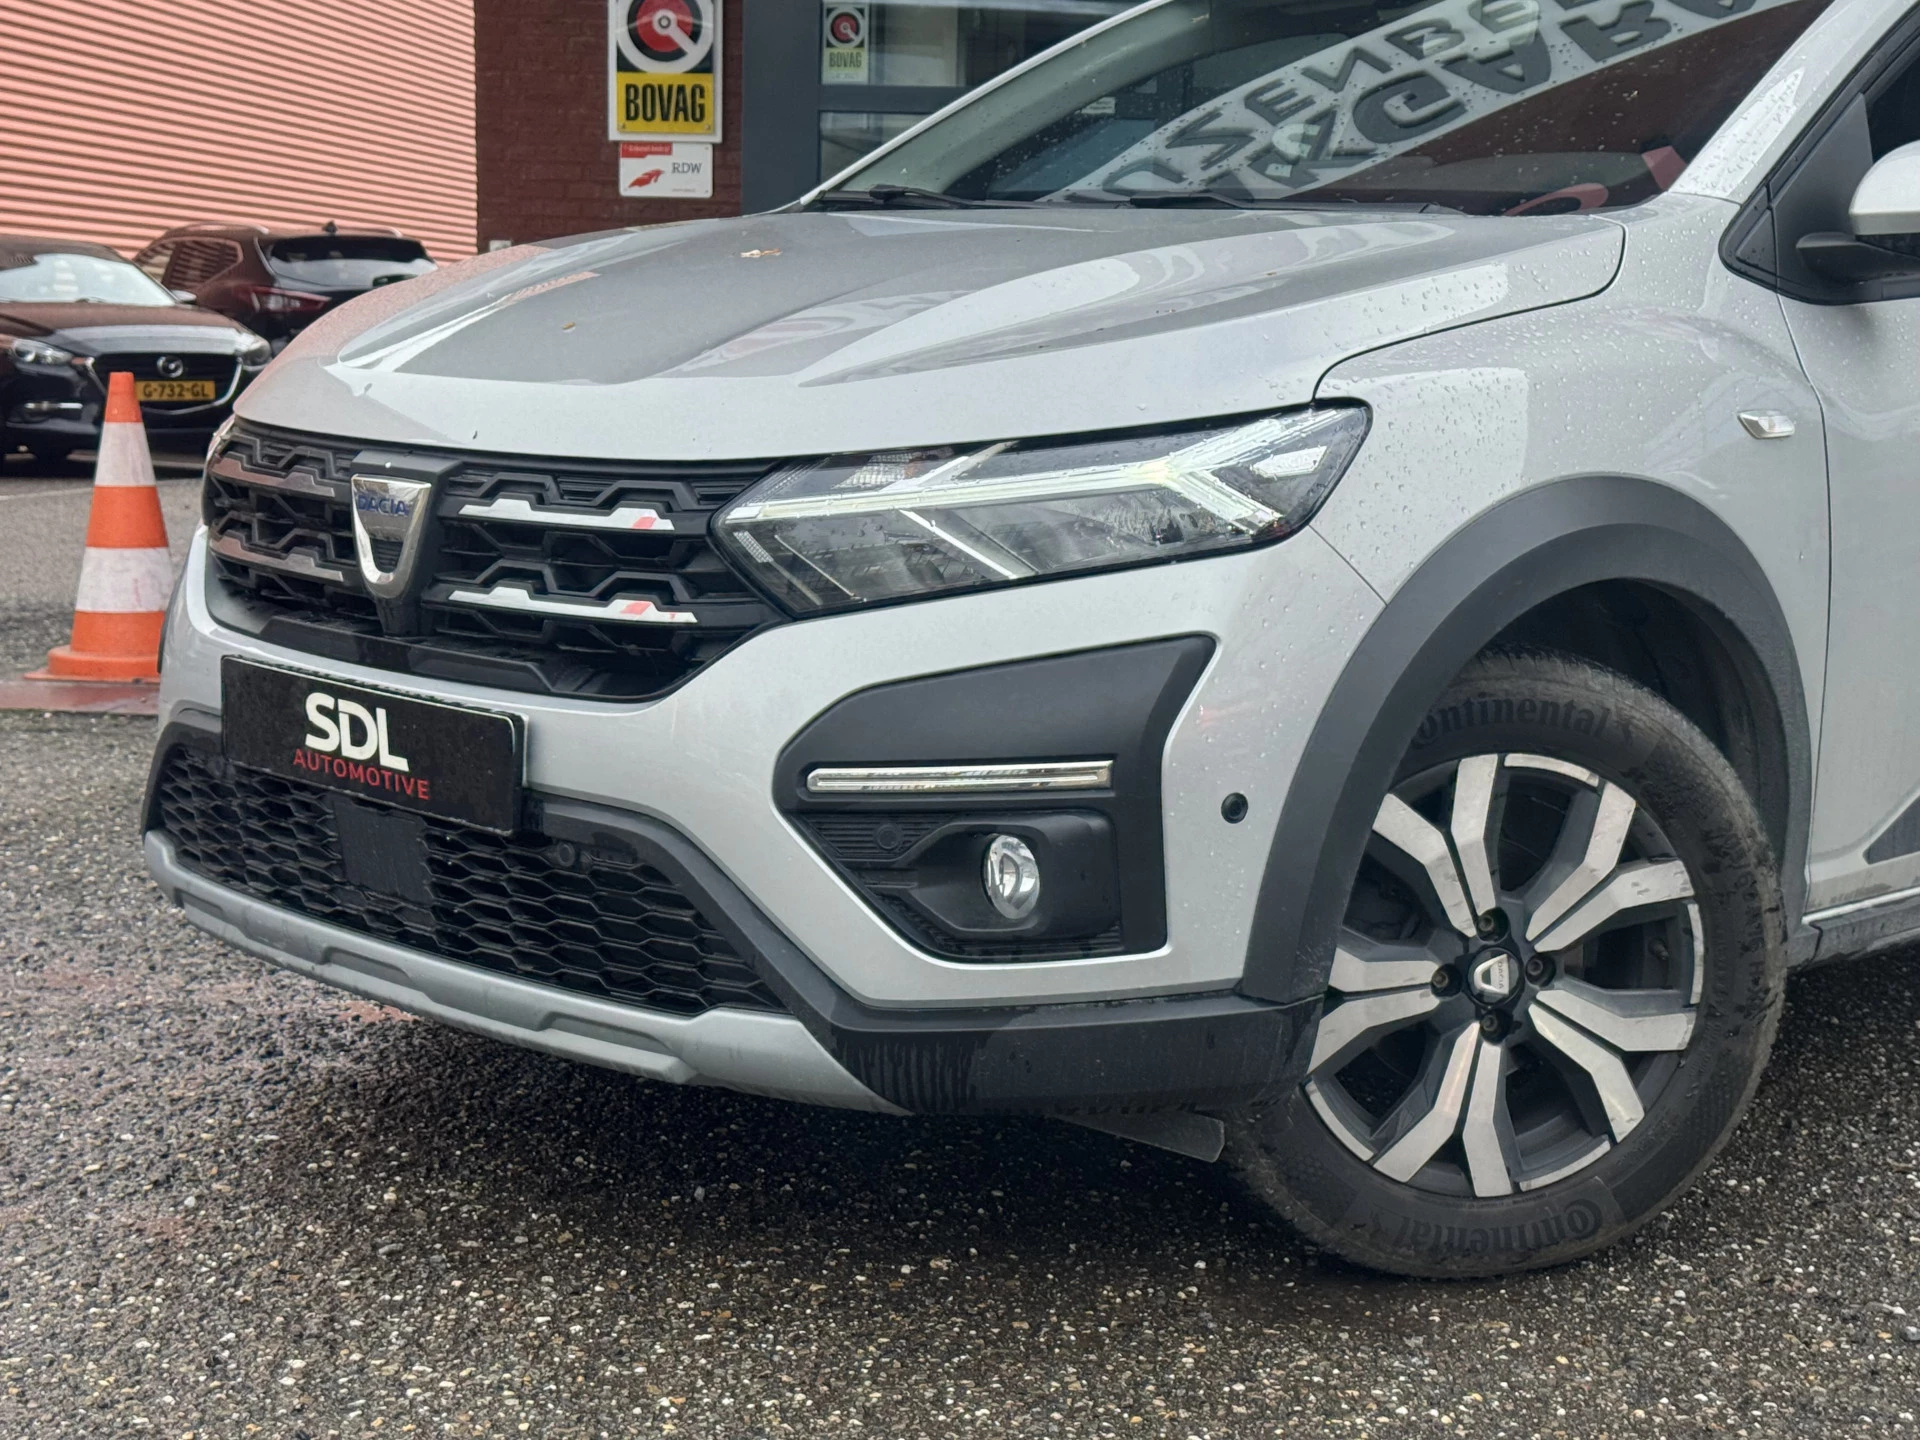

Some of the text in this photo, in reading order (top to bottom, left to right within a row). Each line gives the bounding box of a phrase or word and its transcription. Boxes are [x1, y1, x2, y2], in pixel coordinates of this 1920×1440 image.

[829, 52, 862, 68] BOVAG
[625, 83, 705, 122] BOVAG
[671, 162, 702, 174] RDW
[143, 382, 209, 398] G-732-GL
[357, 494, 410, 516] DACIA
[305, 692, 409, 772] SDL
[293, 748, 430, 800] AUTOMOTIVE
[1391, 1199, 1603, 1255] Continental
